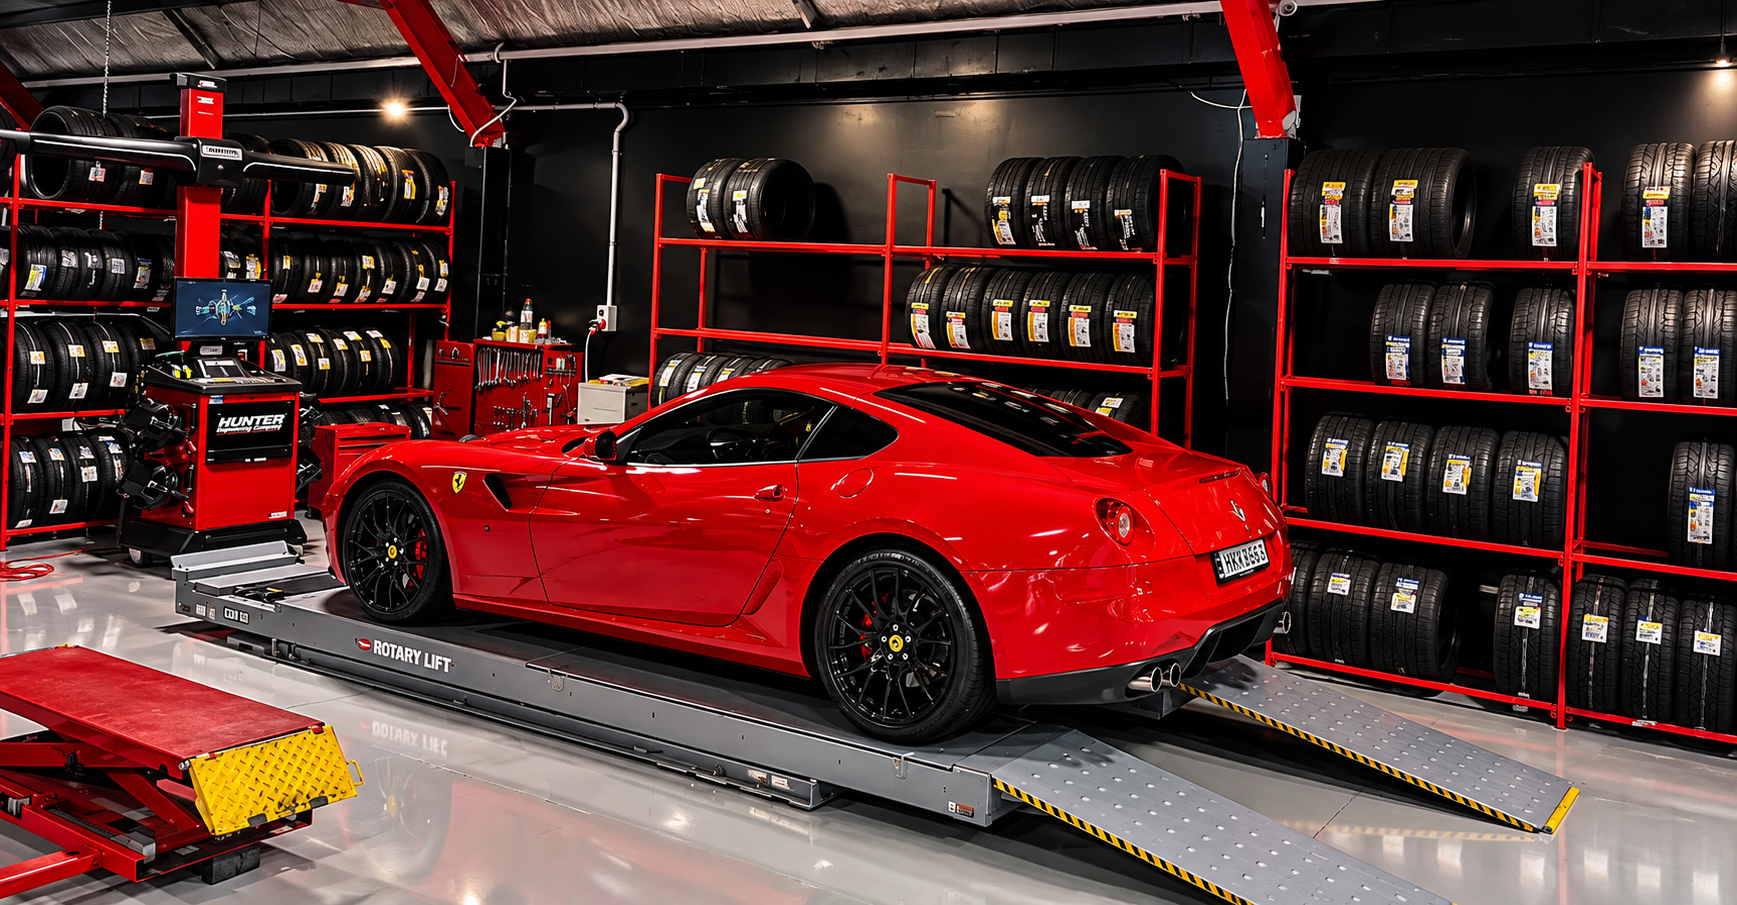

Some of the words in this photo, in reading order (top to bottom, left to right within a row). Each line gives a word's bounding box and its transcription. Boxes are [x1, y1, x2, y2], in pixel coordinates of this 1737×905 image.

[218, 414, 286, 427] HUNTER
[373, 639, 422, 665] ROTARY
[423, 652, 452, 673] LIFT
